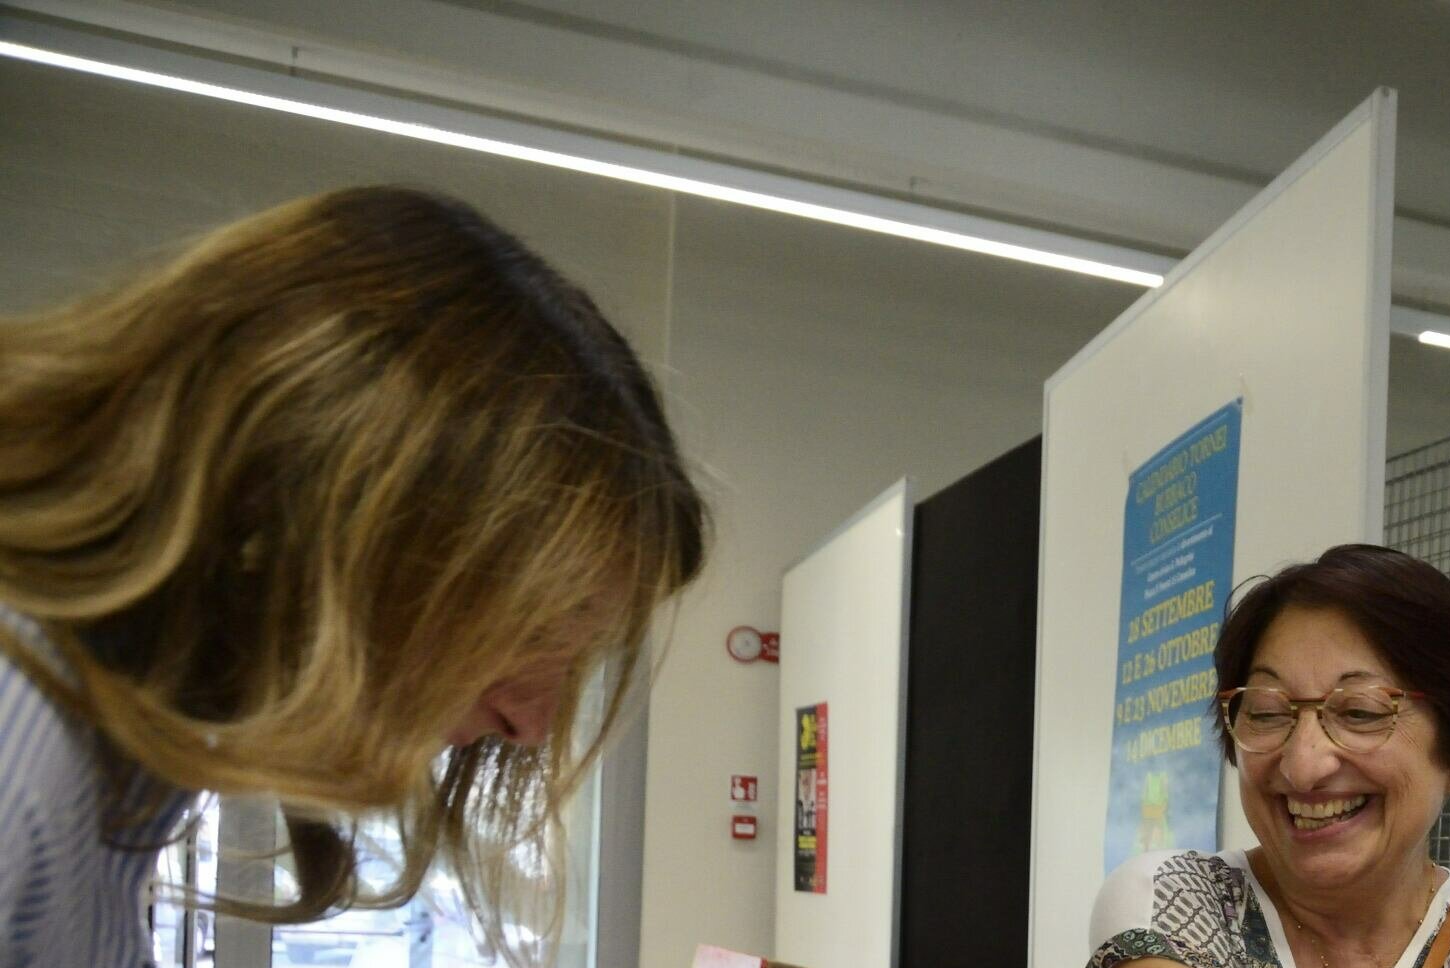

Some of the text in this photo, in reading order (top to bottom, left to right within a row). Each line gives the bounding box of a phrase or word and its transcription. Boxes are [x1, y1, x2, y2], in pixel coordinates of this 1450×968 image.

[1141, 580, 1215, 637] SETTEMBRE
[1158, 622, 1219, 669] OTTOBRE
[1147, 668, 1218, 713] NOVEMBRE
[1140, 716, 1202, 758] DICEMBRE
